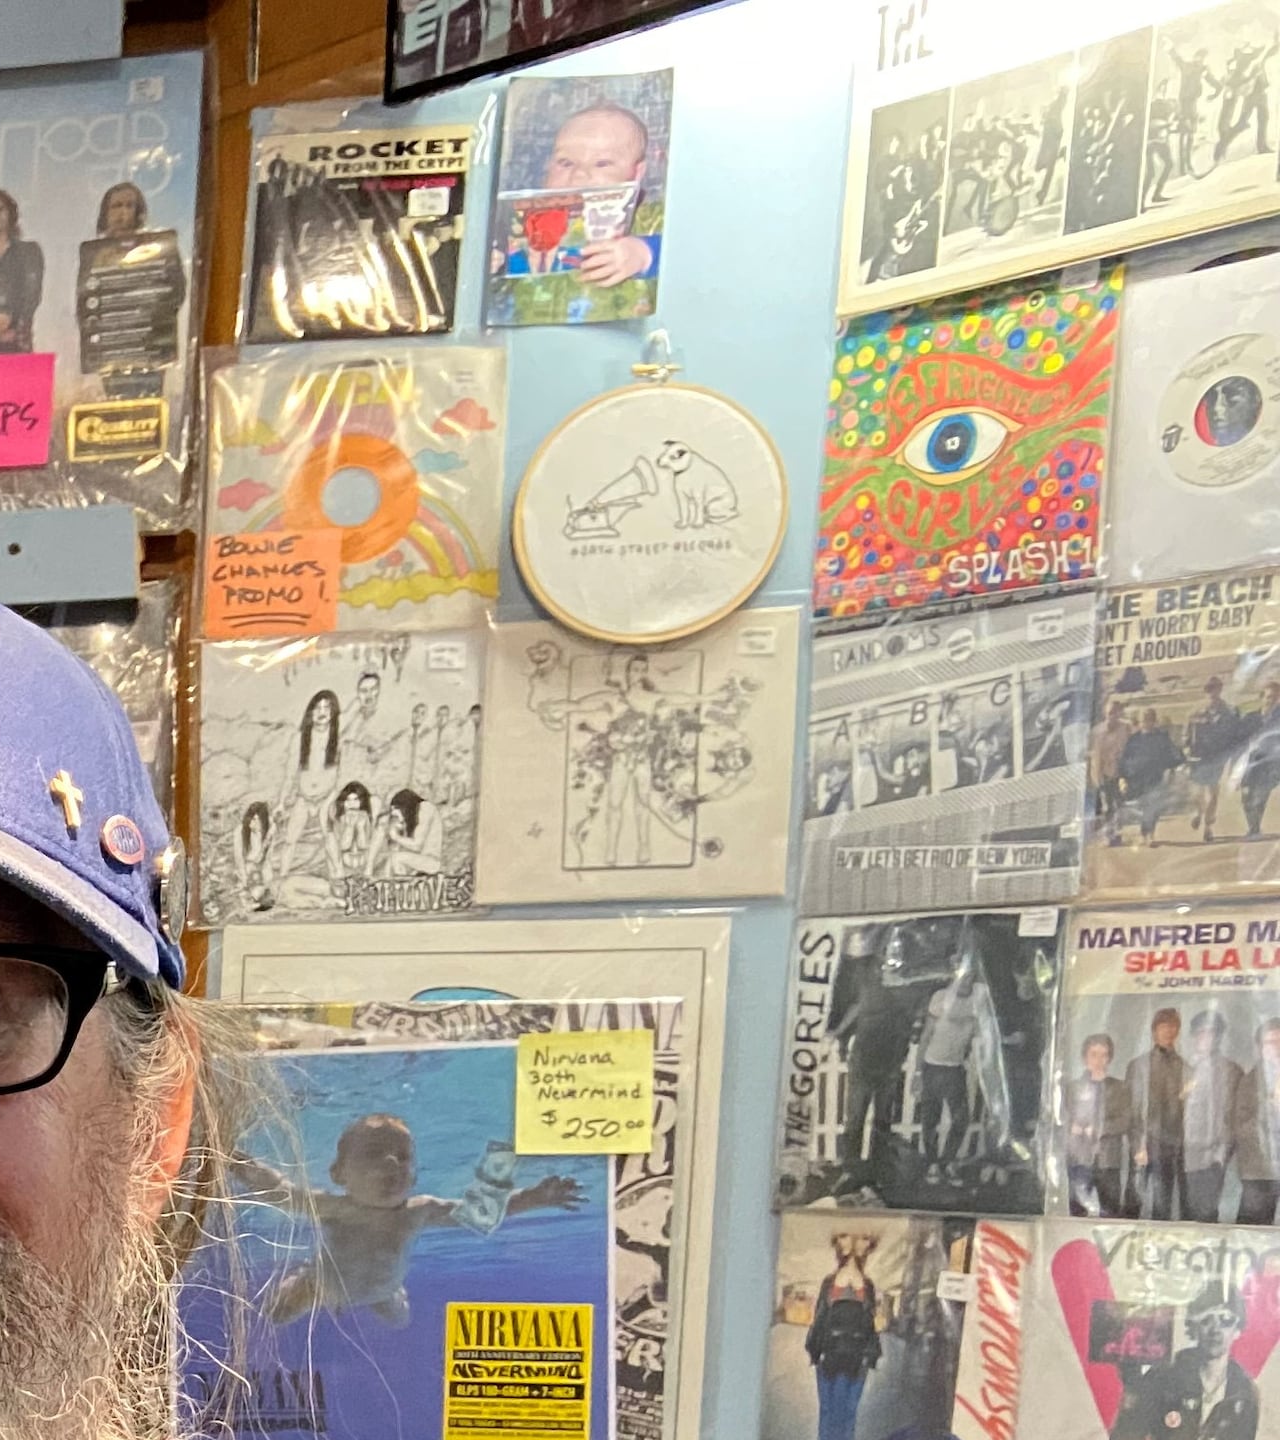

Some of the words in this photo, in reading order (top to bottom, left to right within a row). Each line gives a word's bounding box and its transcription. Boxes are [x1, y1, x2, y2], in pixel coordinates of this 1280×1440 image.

[308, 137, 470, 162] ROCKET
[333, 161, 377, 174] FROM
[383, 159, 410, 171] THE
[416, 157, 465, 170] CRYPT
[948, 541, 1071, 589] SPLASH
[1155, 574, 1274, 614] BEACH
[1140, 611, 1202, 640] WORRY
[1207, 604, 1256, 631] BABY
[1131, 635, 1203, 664] AROUND
[1078, 921, 1237, 951] MANFRED
[1123, 949, 1191, 973] SHA
[1201, 947, 1241, 972] LA
[1157, 976, 1204, 989] JOHN
[1210, 973, 1268, 989] HARDY
[788, 930, 836, 1099] GORIES
[532, 1048, 614, 1069] Nirvana
[528, 1068, 577, 1087] 30th
[538, 1083, 643, 1102] Nevermind
[454, 1309, 584, 1348] NIRVANA
[451, 1361, 584, 1380] NEVERMIND
